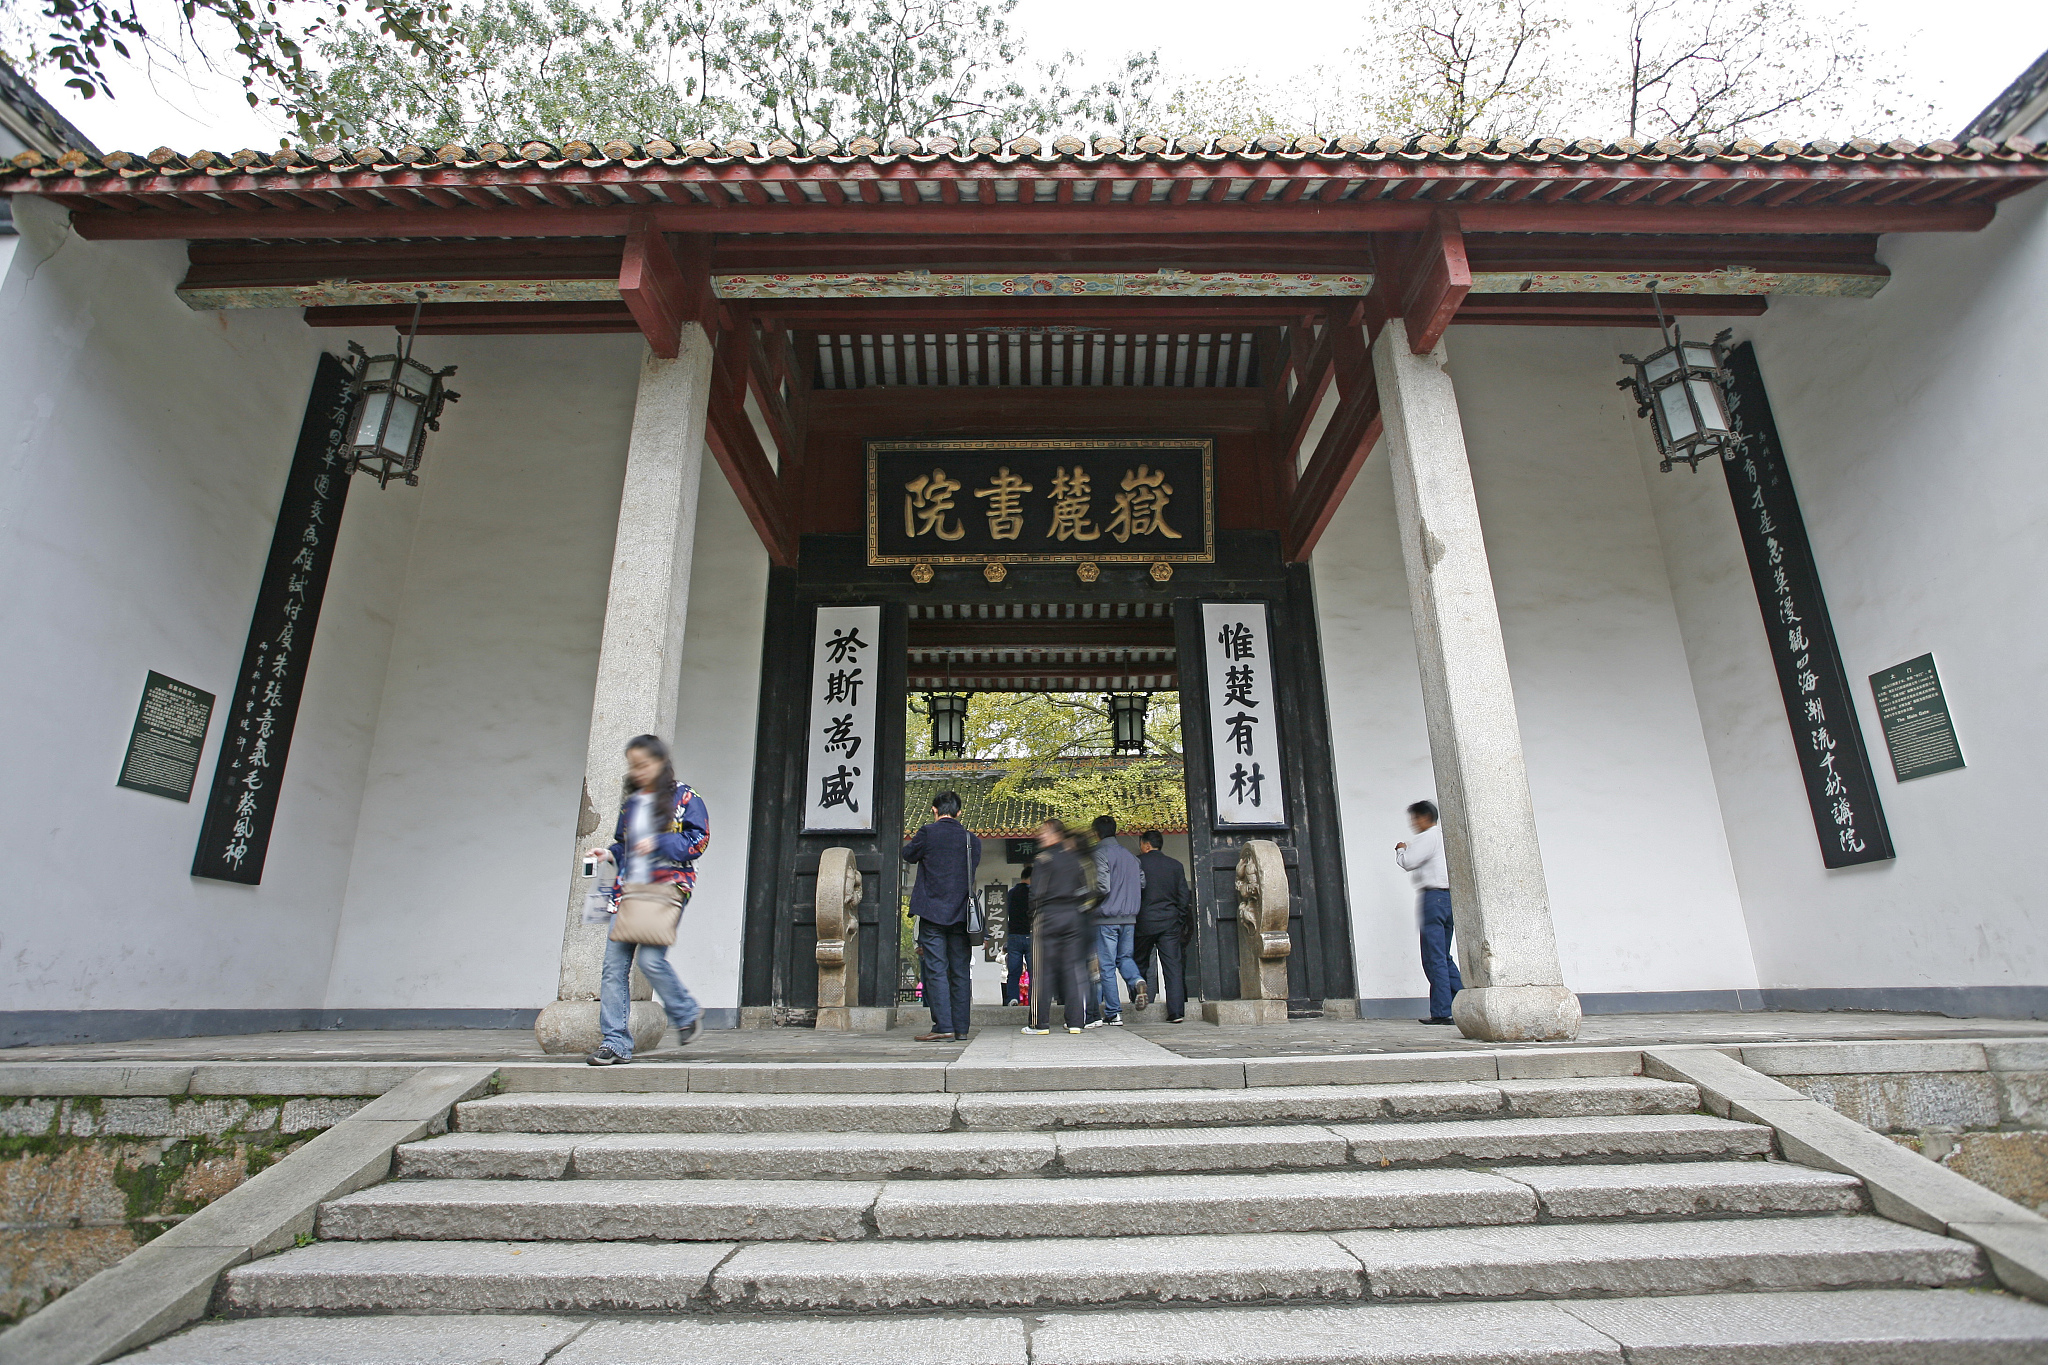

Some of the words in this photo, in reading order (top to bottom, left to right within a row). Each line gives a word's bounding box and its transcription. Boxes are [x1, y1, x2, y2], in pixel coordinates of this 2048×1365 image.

[904, 464, 1183, 543] 嶽麓書院
[1218, 622, 1265, 807] 惟楚有材
